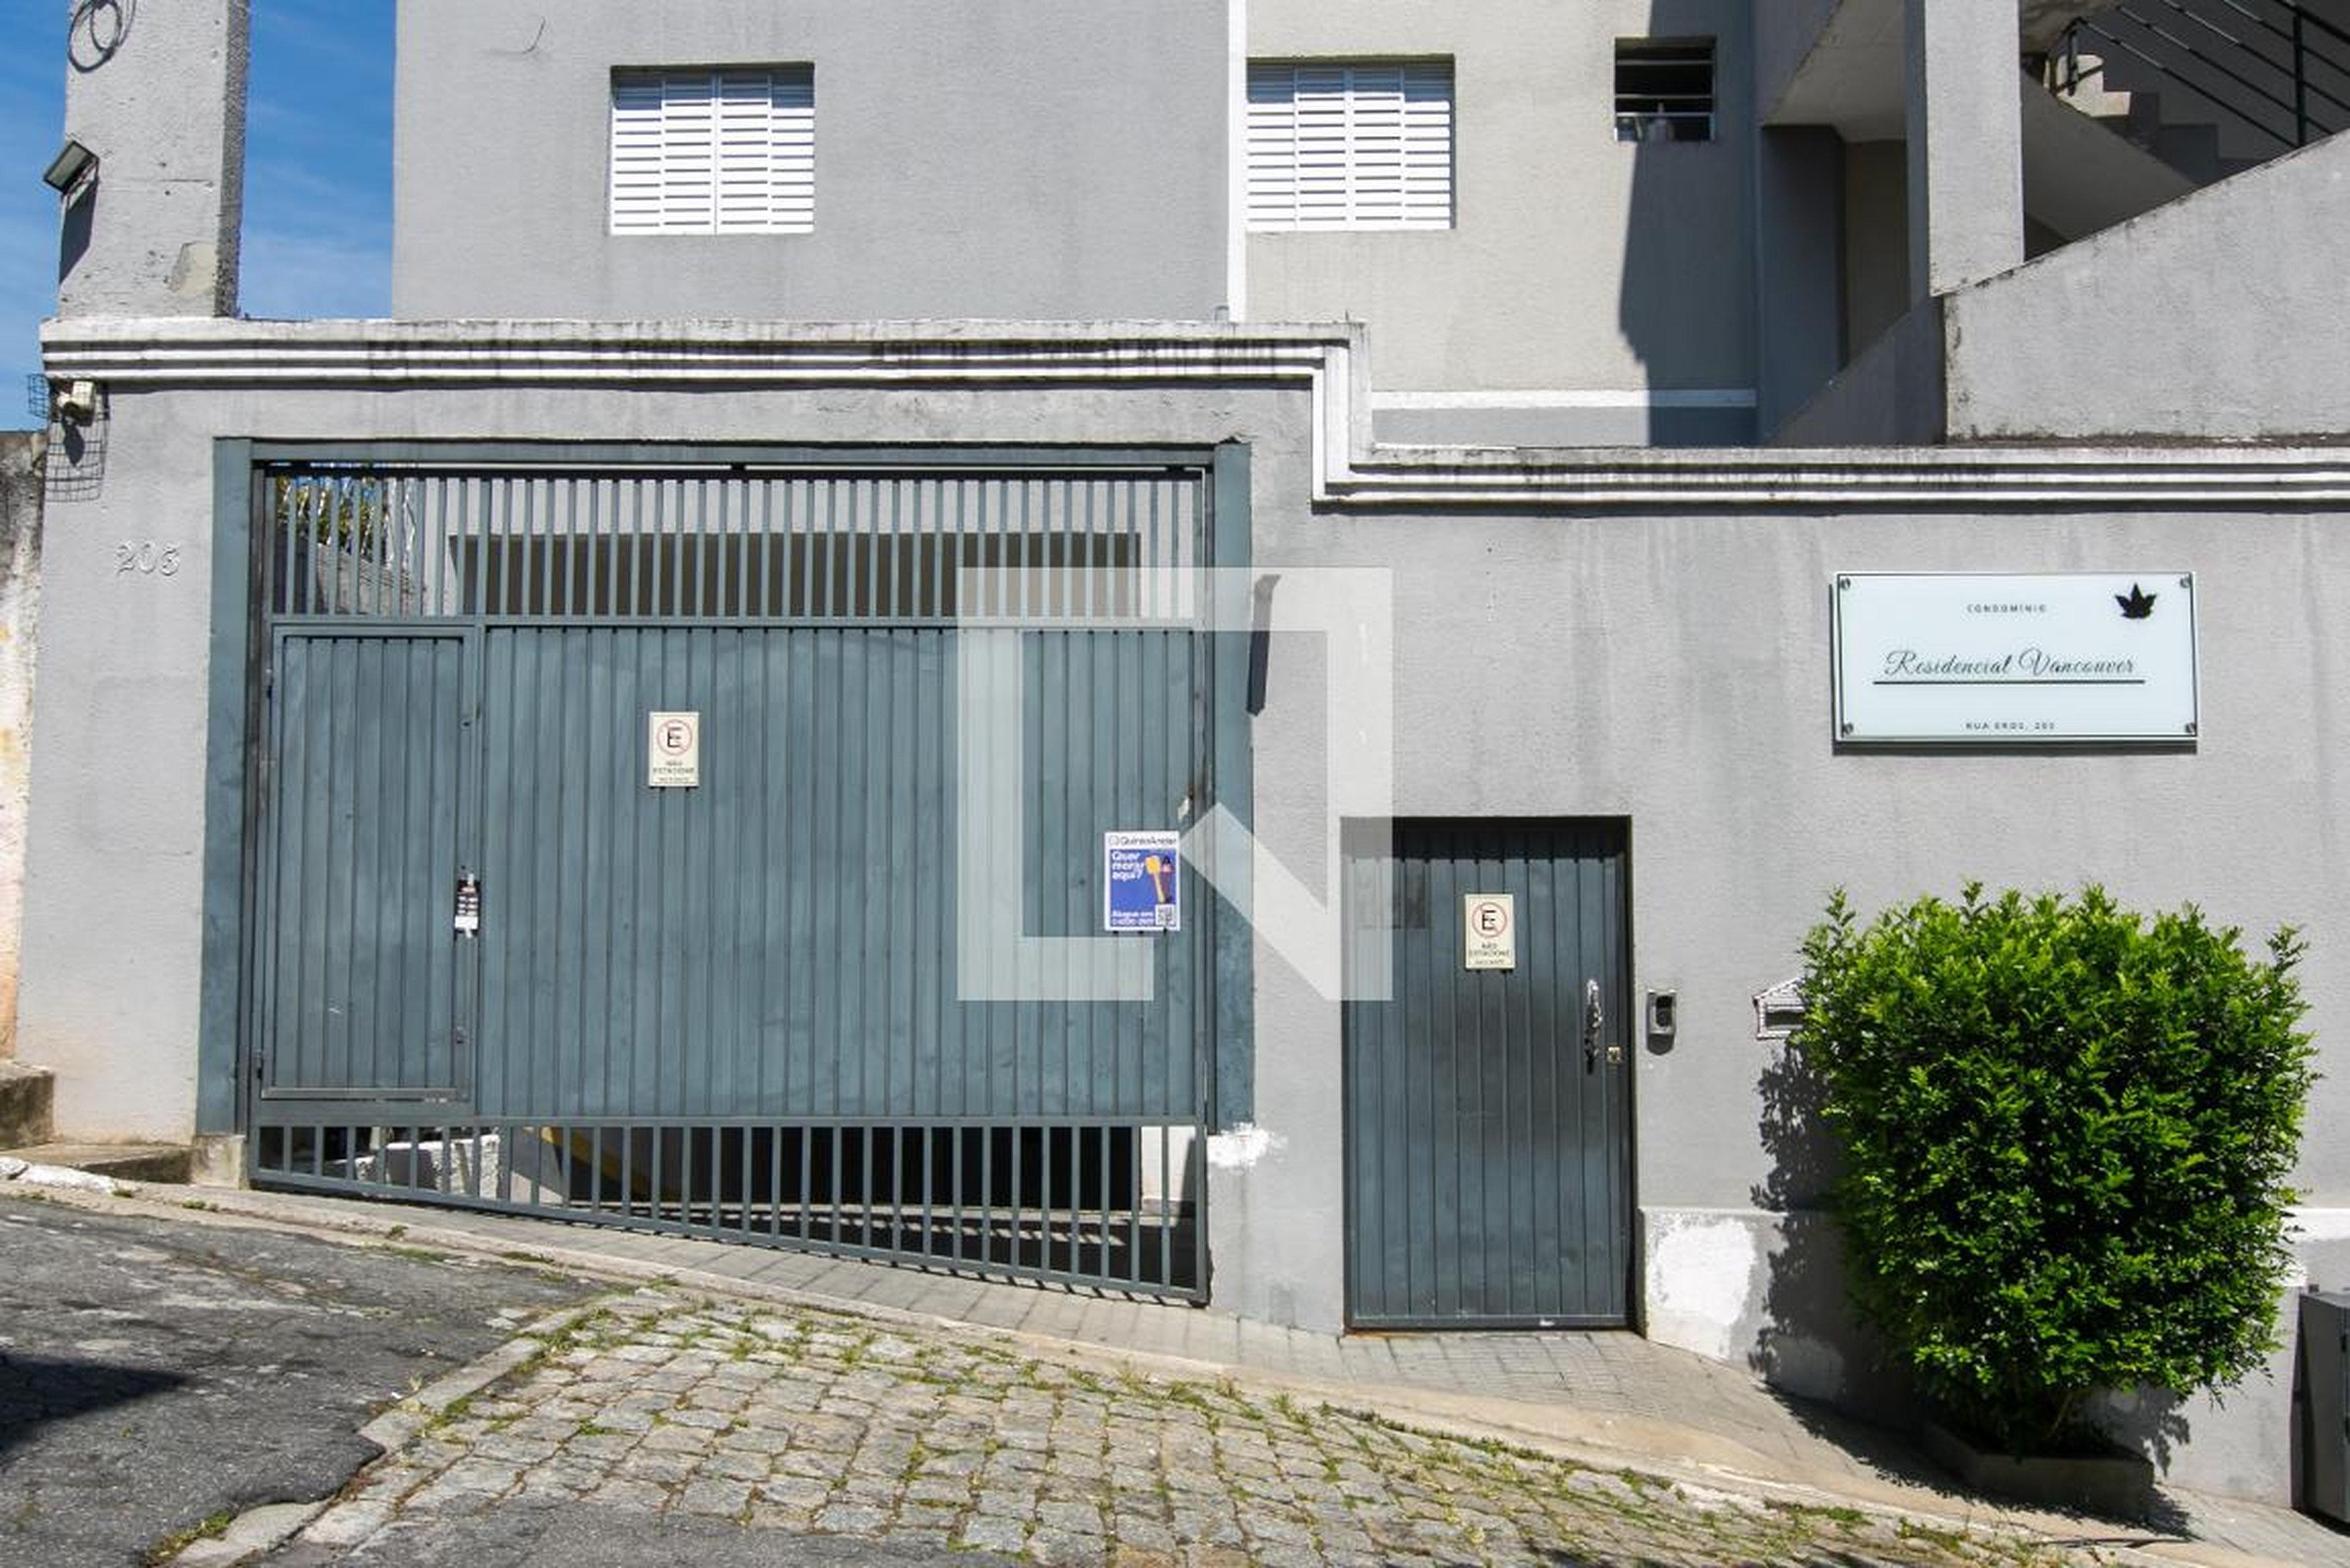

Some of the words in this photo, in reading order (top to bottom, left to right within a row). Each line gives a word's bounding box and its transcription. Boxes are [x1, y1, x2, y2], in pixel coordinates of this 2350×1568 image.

[1884, 651, 2012, 674] Residencial
[2018, 647, 2133, 676] Vancouver
[667, 727, 682, 748] E
[1112, 851, 1141, 861] Quer
[1112, 862, 1144, 871] morar
[1482, 909, 1496, 930] E
